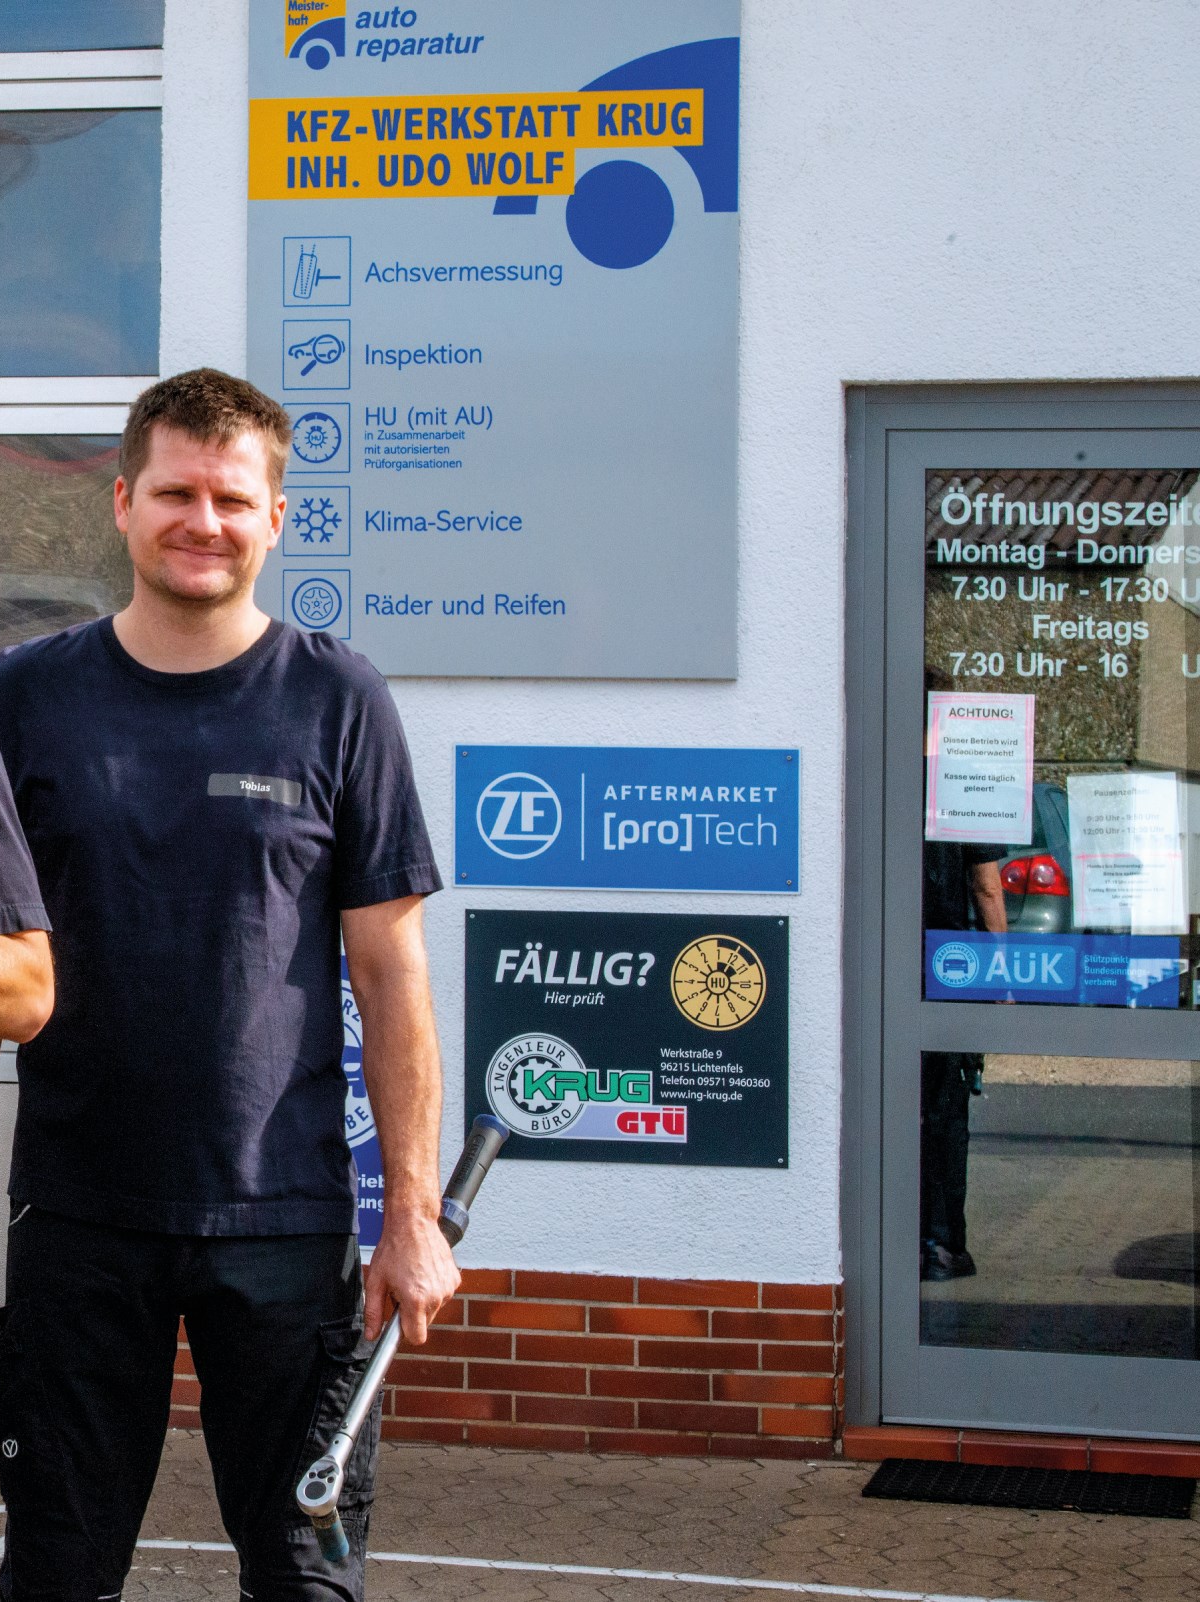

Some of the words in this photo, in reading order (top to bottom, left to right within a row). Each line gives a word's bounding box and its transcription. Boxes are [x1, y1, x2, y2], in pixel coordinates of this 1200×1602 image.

[288, 0, 329, 11] Meister-
[288, 14, 308, 25] haft
[356, 6, 417, 29] auto
[356, 33, 484, 62] reparatur
[287, 103, 581, 142] KFZ-WERKSTATT
[597, 102, 692, 137] KRUG
[287, 156, 360, 188] INH.
[378, 153, 451, 187] UDO
[467, 151, 564, 185] WOLF
[365, 261, 563, 286] Achsvermessung
[365, 344, 482, 370] Inspektion
[365, 406, 397, 426] HU
[407, 406, 447, 430] (mit
[455, 405, 493, 430] AU)
[364, 430, 373, 440] in
[377, 430, 465, 440] Zusammenarbeit
[364, 445, 380, 454] mit
[384, 444, 450, 455] autorisierten
[364, 458, 462, 471] Prüforganisationen
[365, 510, 523, 533] Klima-Service
[937, 539, 1045, 570] Montag
[951, 576, 1006, 601] 7.30
[1018, 576, 1069, 601] Uhr
[1100, 577, 1169, 602] 17.30
[365, 594, 432, 616] Räder
[442, 594, 485, 616] und
[494, 594, 566, 616] Reifen
[1033, 615, 1149, 646] Freitags
[950, 652, 1004, 676] 7.30
[1017, 653, 1067, 677] Uhr
[1099, 654, 1129, 677] 16
[948, 707, 1013, 718] ACHTUNG!
[971, 737, 999, 745] Betrieb
[947, 748, 1014, 757] Videoüberwacht!
[240, 780, 271, 792] Tobias
[988, 774, 1015, 782] täglich
[603, 785, 777, 803] AFTERMARKET
[964, 785, 994, 793] geleert!
[484, 790, 556, 841] ZF
[941, 809, 975, 817] Einbruch
[977, 811, 1017, 819] zwecklos!
[603, 812, 777, 852] [pro]Tech
[495, 942, 655, 987] FÄLLIG?
[1084, 955, 1128, 964] Stützpunkt
[711, 977, 726, 988] HU
[1084, 978, 1117, 986] verband
[544, 991, 570, 1006] Hier
[573, 991, 605, 1009] prüft
[660, 1048, 714, 1059] Werkstraße
[716, 1050, 723, 1059] 9
[494, 1041, 565, 1092] INGENIEUR
[660, 1062, 690, 1072] 96215
[692, 1063, 743, 1074] Lichtenfels
[523, 1069, 651, 1104] KRUG
[660, 1075, 695, 1086] Telefon
[697, 1077, 726, 1087] 09571
[728, 1078, 771, 1088] 9460360
[660, 1089, 743, 1102] www.ing-krug.de
[531, 1108, 572, 1131] BÜRO
[616, 1107, 685, 1135] GTÜ
